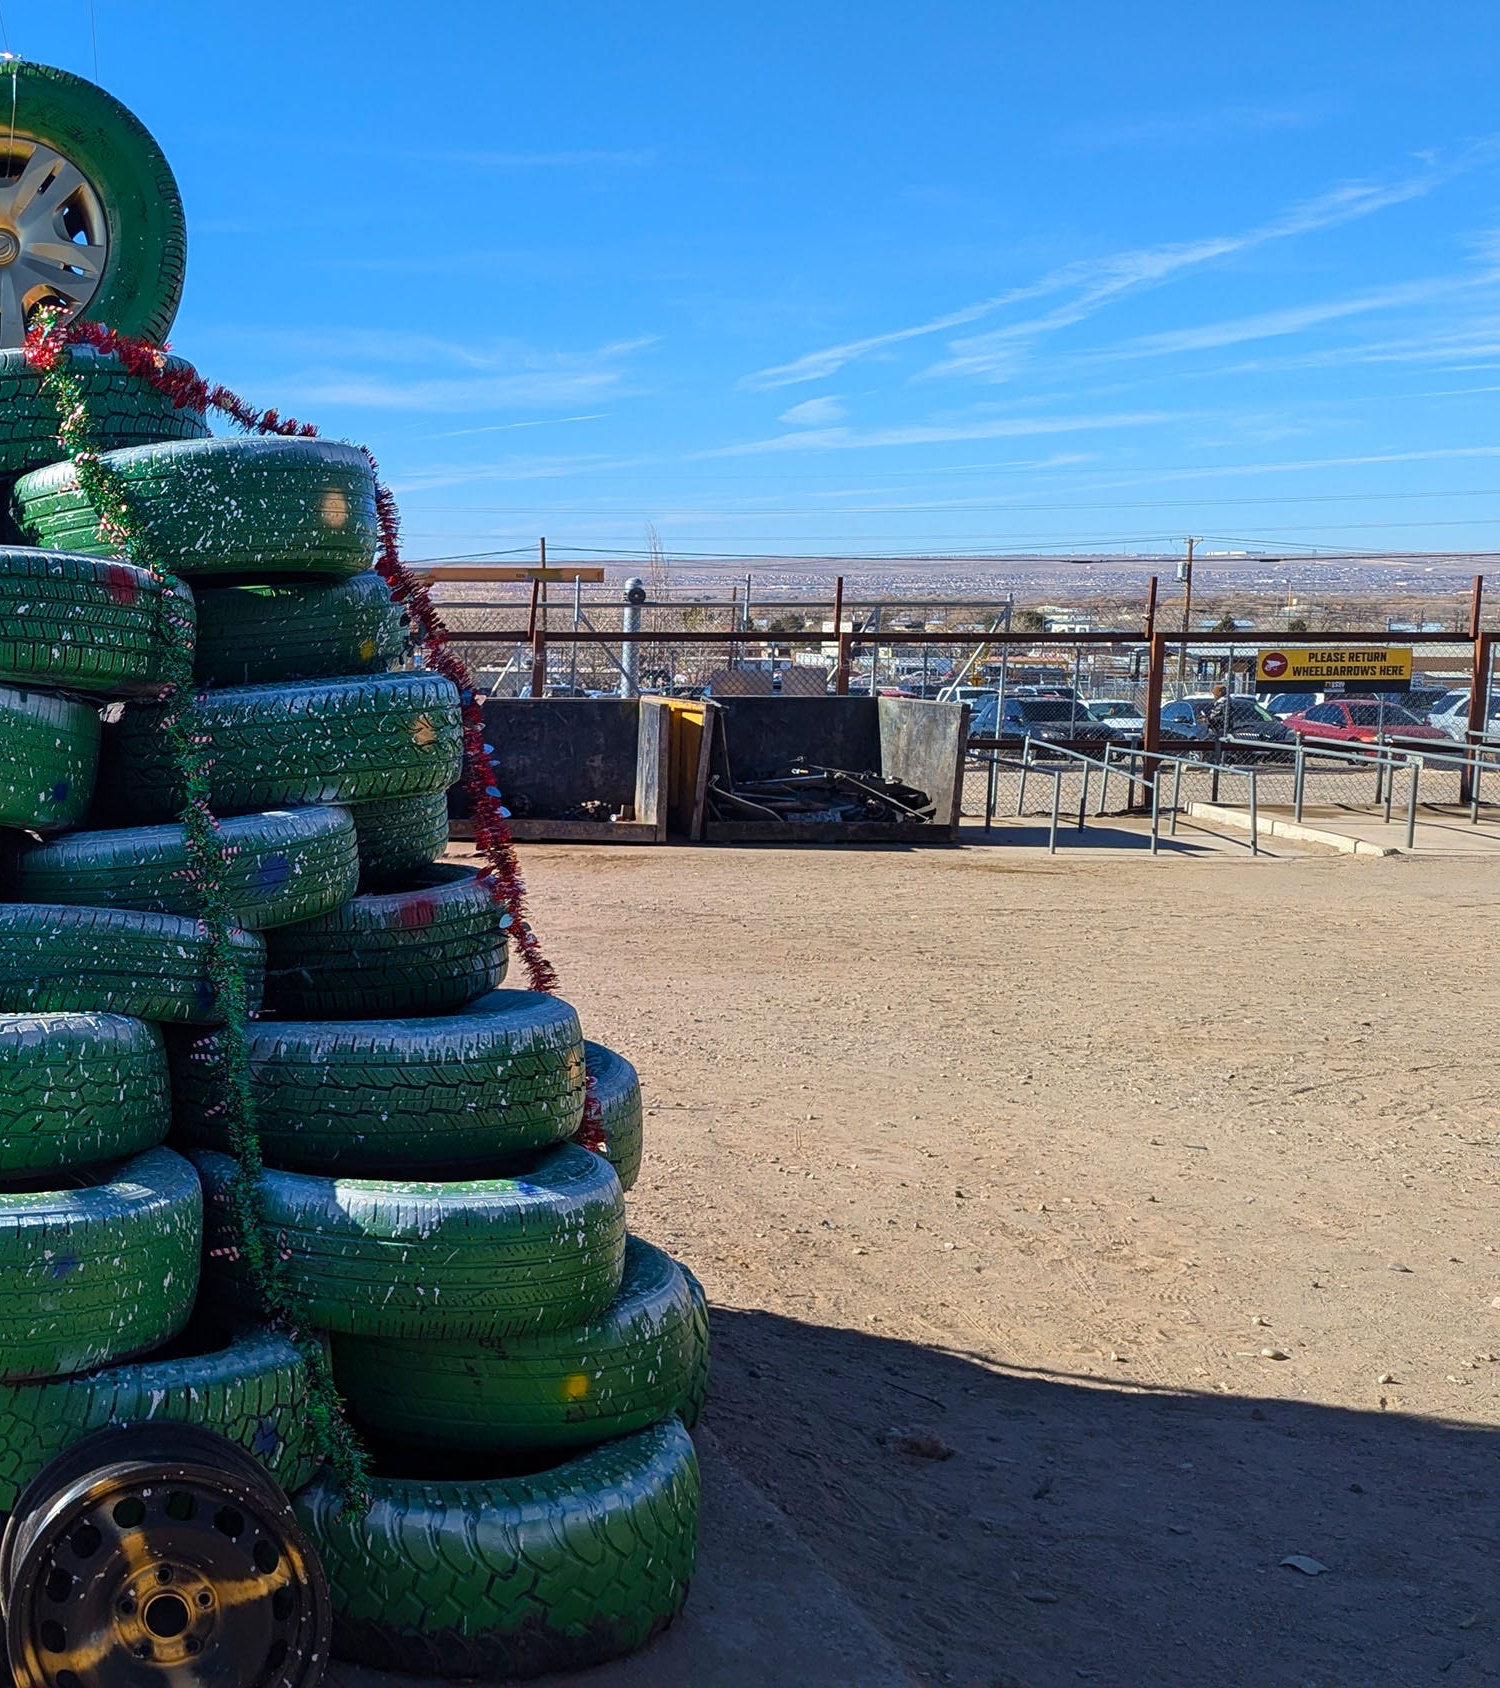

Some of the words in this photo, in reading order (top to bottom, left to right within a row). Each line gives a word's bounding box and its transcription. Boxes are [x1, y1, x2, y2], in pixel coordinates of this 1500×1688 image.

[1308, 652, 1346, 663] PLEASE
[1348, 652, 1387, 662] RETURN
[1292, 666, 1377, 676] WHEELBARROWS
[1380, 665, 1405, 676] HERE
